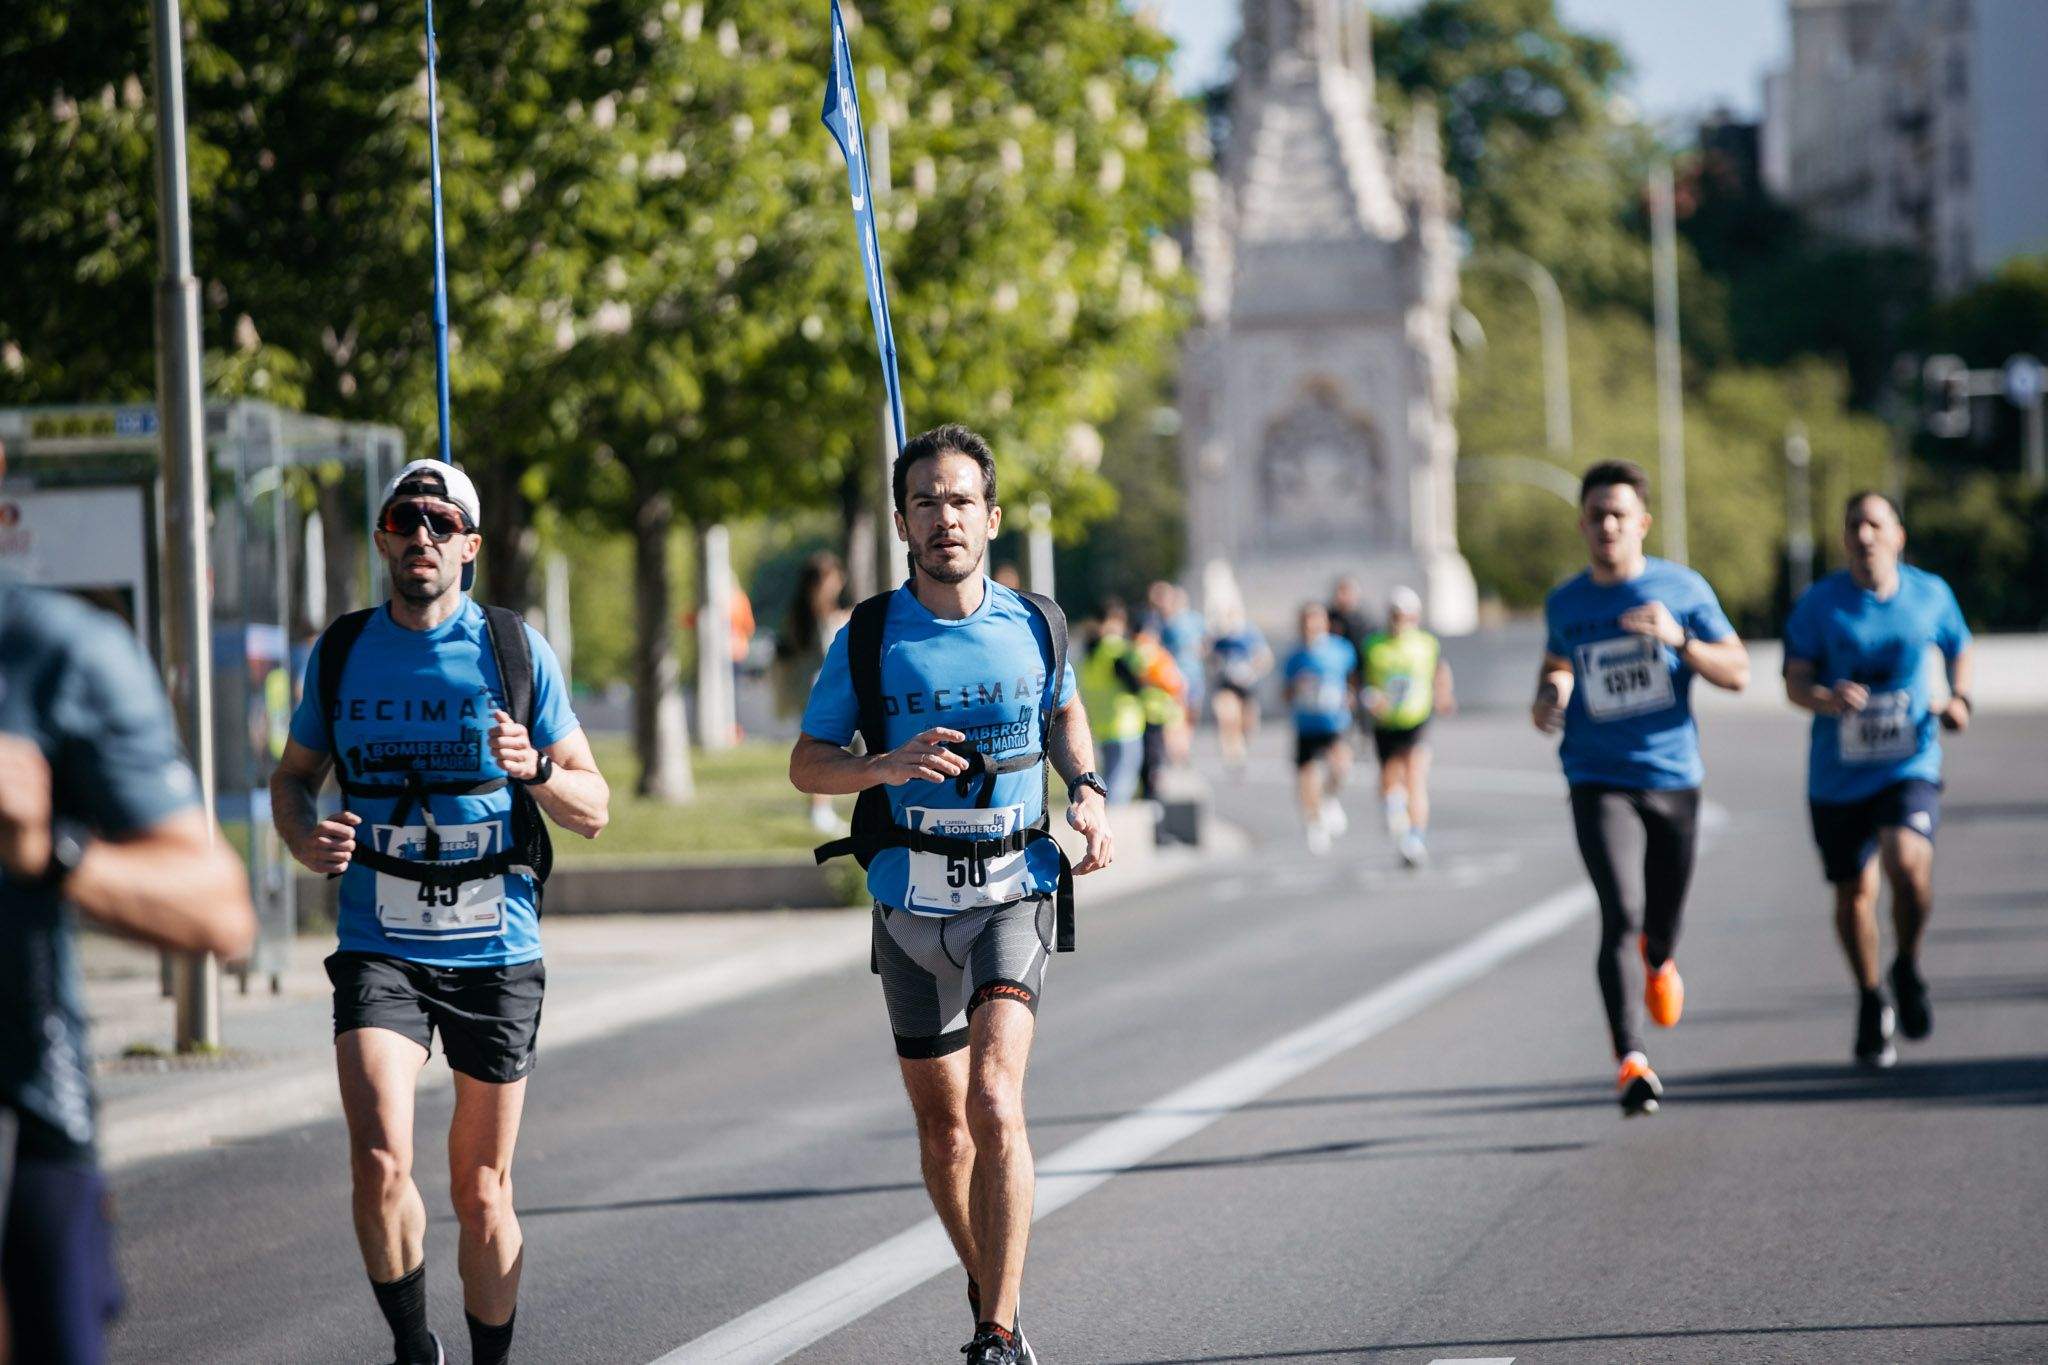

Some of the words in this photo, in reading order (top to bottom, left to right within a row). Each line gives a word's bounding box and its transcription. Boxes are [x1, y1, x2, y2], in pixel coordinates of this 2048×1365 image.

[966, 721, 1028, 741] MBEROS
[373, 742, 479, 757] BOMBEROS
[977, 740, 990, 753] de
[992, 734, 1027, 753] MADRID
[412, 756, 427, 769] de
[430, 755, 478, 770] MADRID
[944, 824, 1004, 835] BOMBEROS
[415, 840, 478, 853] BBEROS
[946, 853, 987, 889] 50
